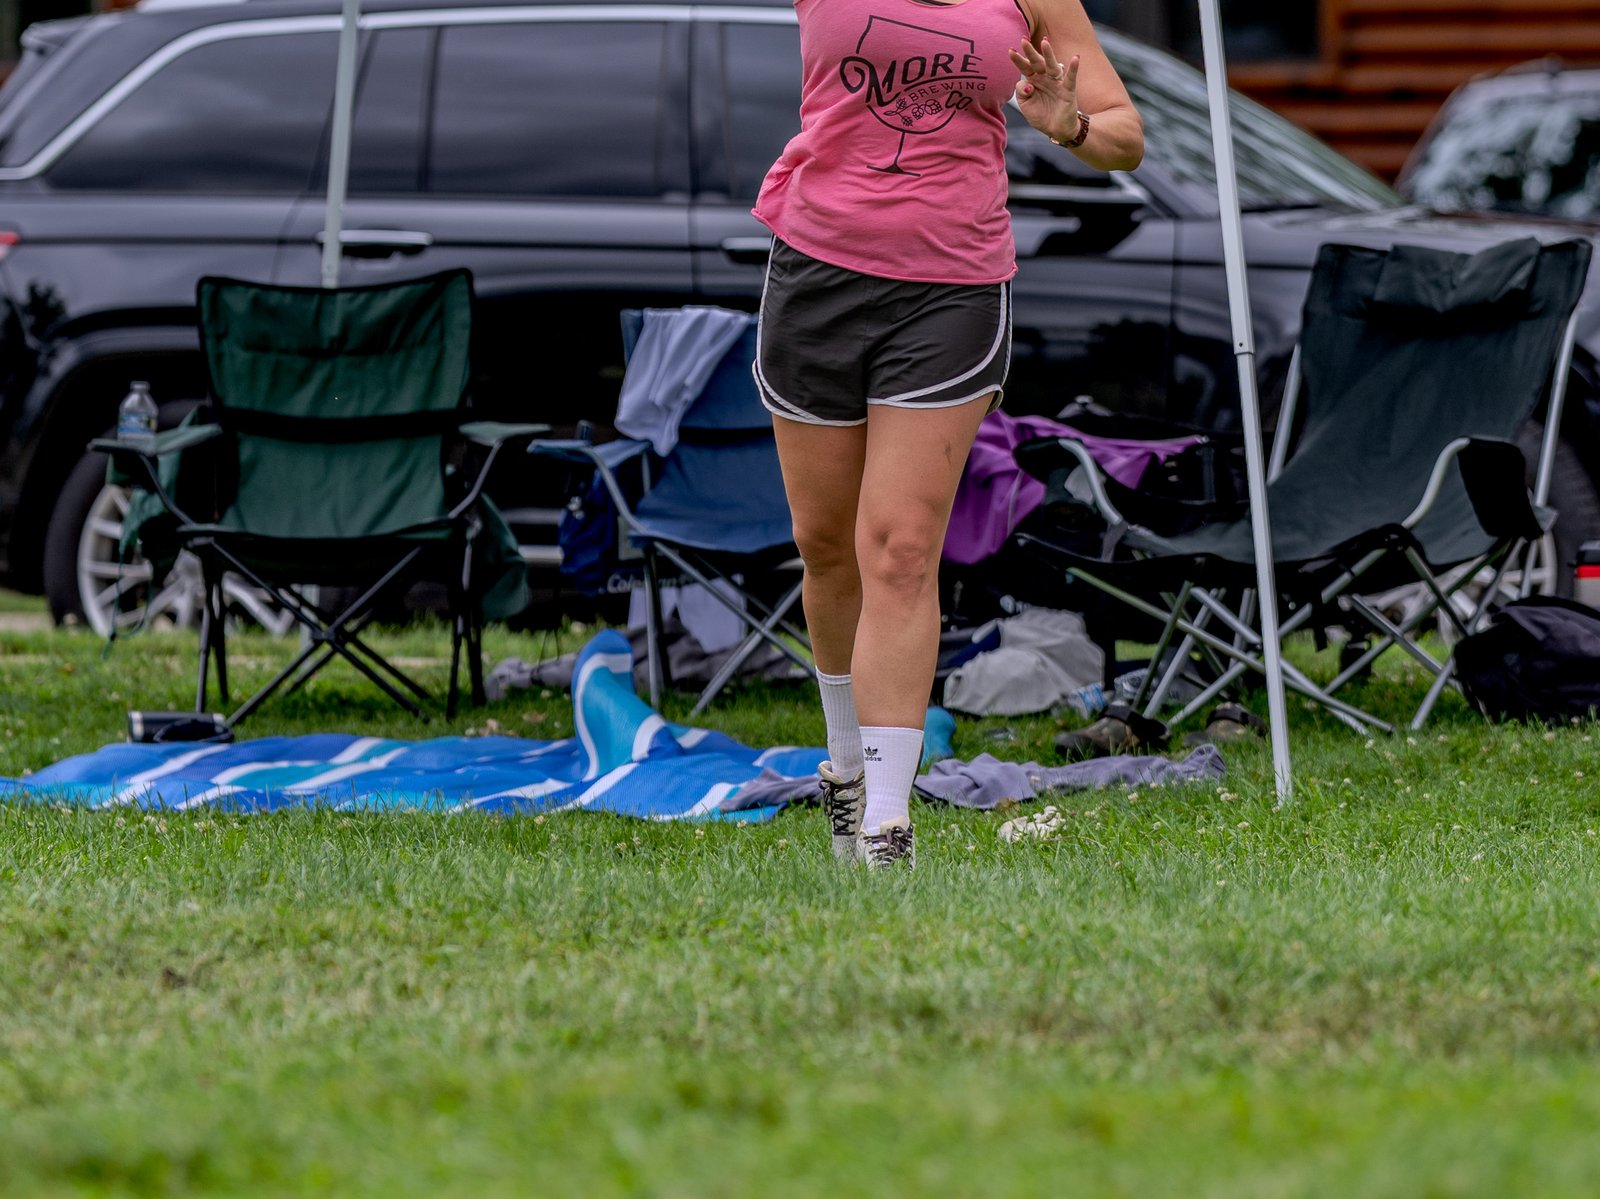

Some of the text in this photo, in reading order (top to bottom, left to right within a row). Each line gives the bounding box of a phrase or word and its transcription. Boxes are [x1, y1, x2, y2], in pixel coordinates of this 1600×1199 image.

[840, 52, 983, 107] MORE
[909, 81, 986, 102] BREWING
[607, 573, 677, 593] Colean
